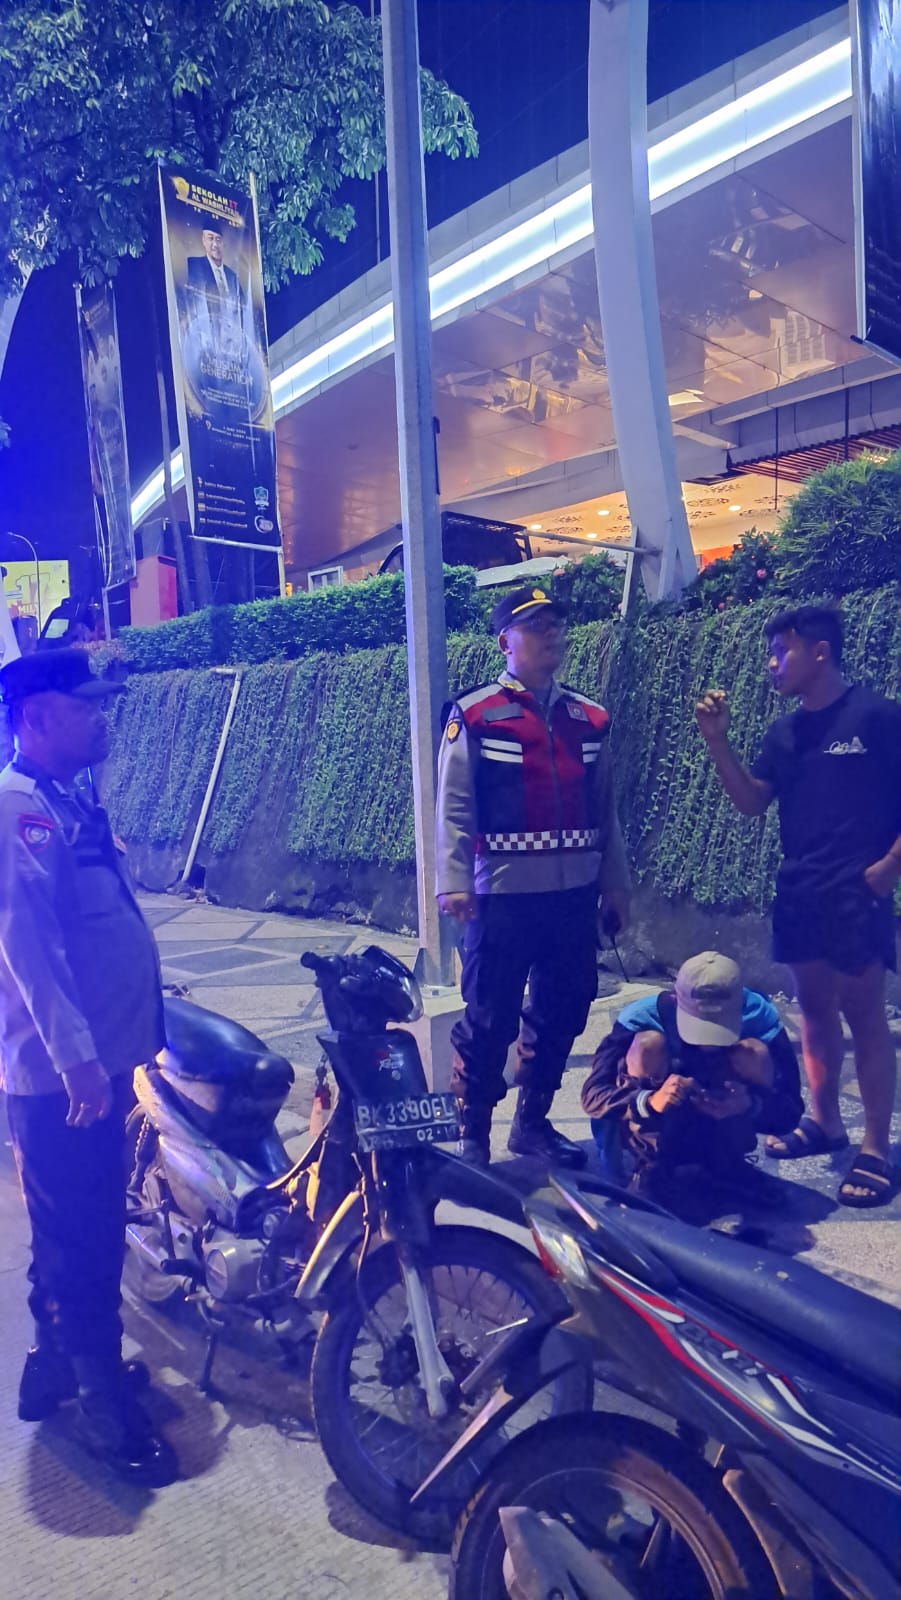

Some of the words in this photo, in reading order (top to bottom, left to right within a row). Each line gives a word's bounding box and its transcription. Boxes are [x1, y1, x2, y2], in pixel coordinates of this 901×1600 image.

[191, 184, 228, 206] SEKOLAH
[229, 199, 238, 209] IT
[357, 1104, 383, 1128] BK
